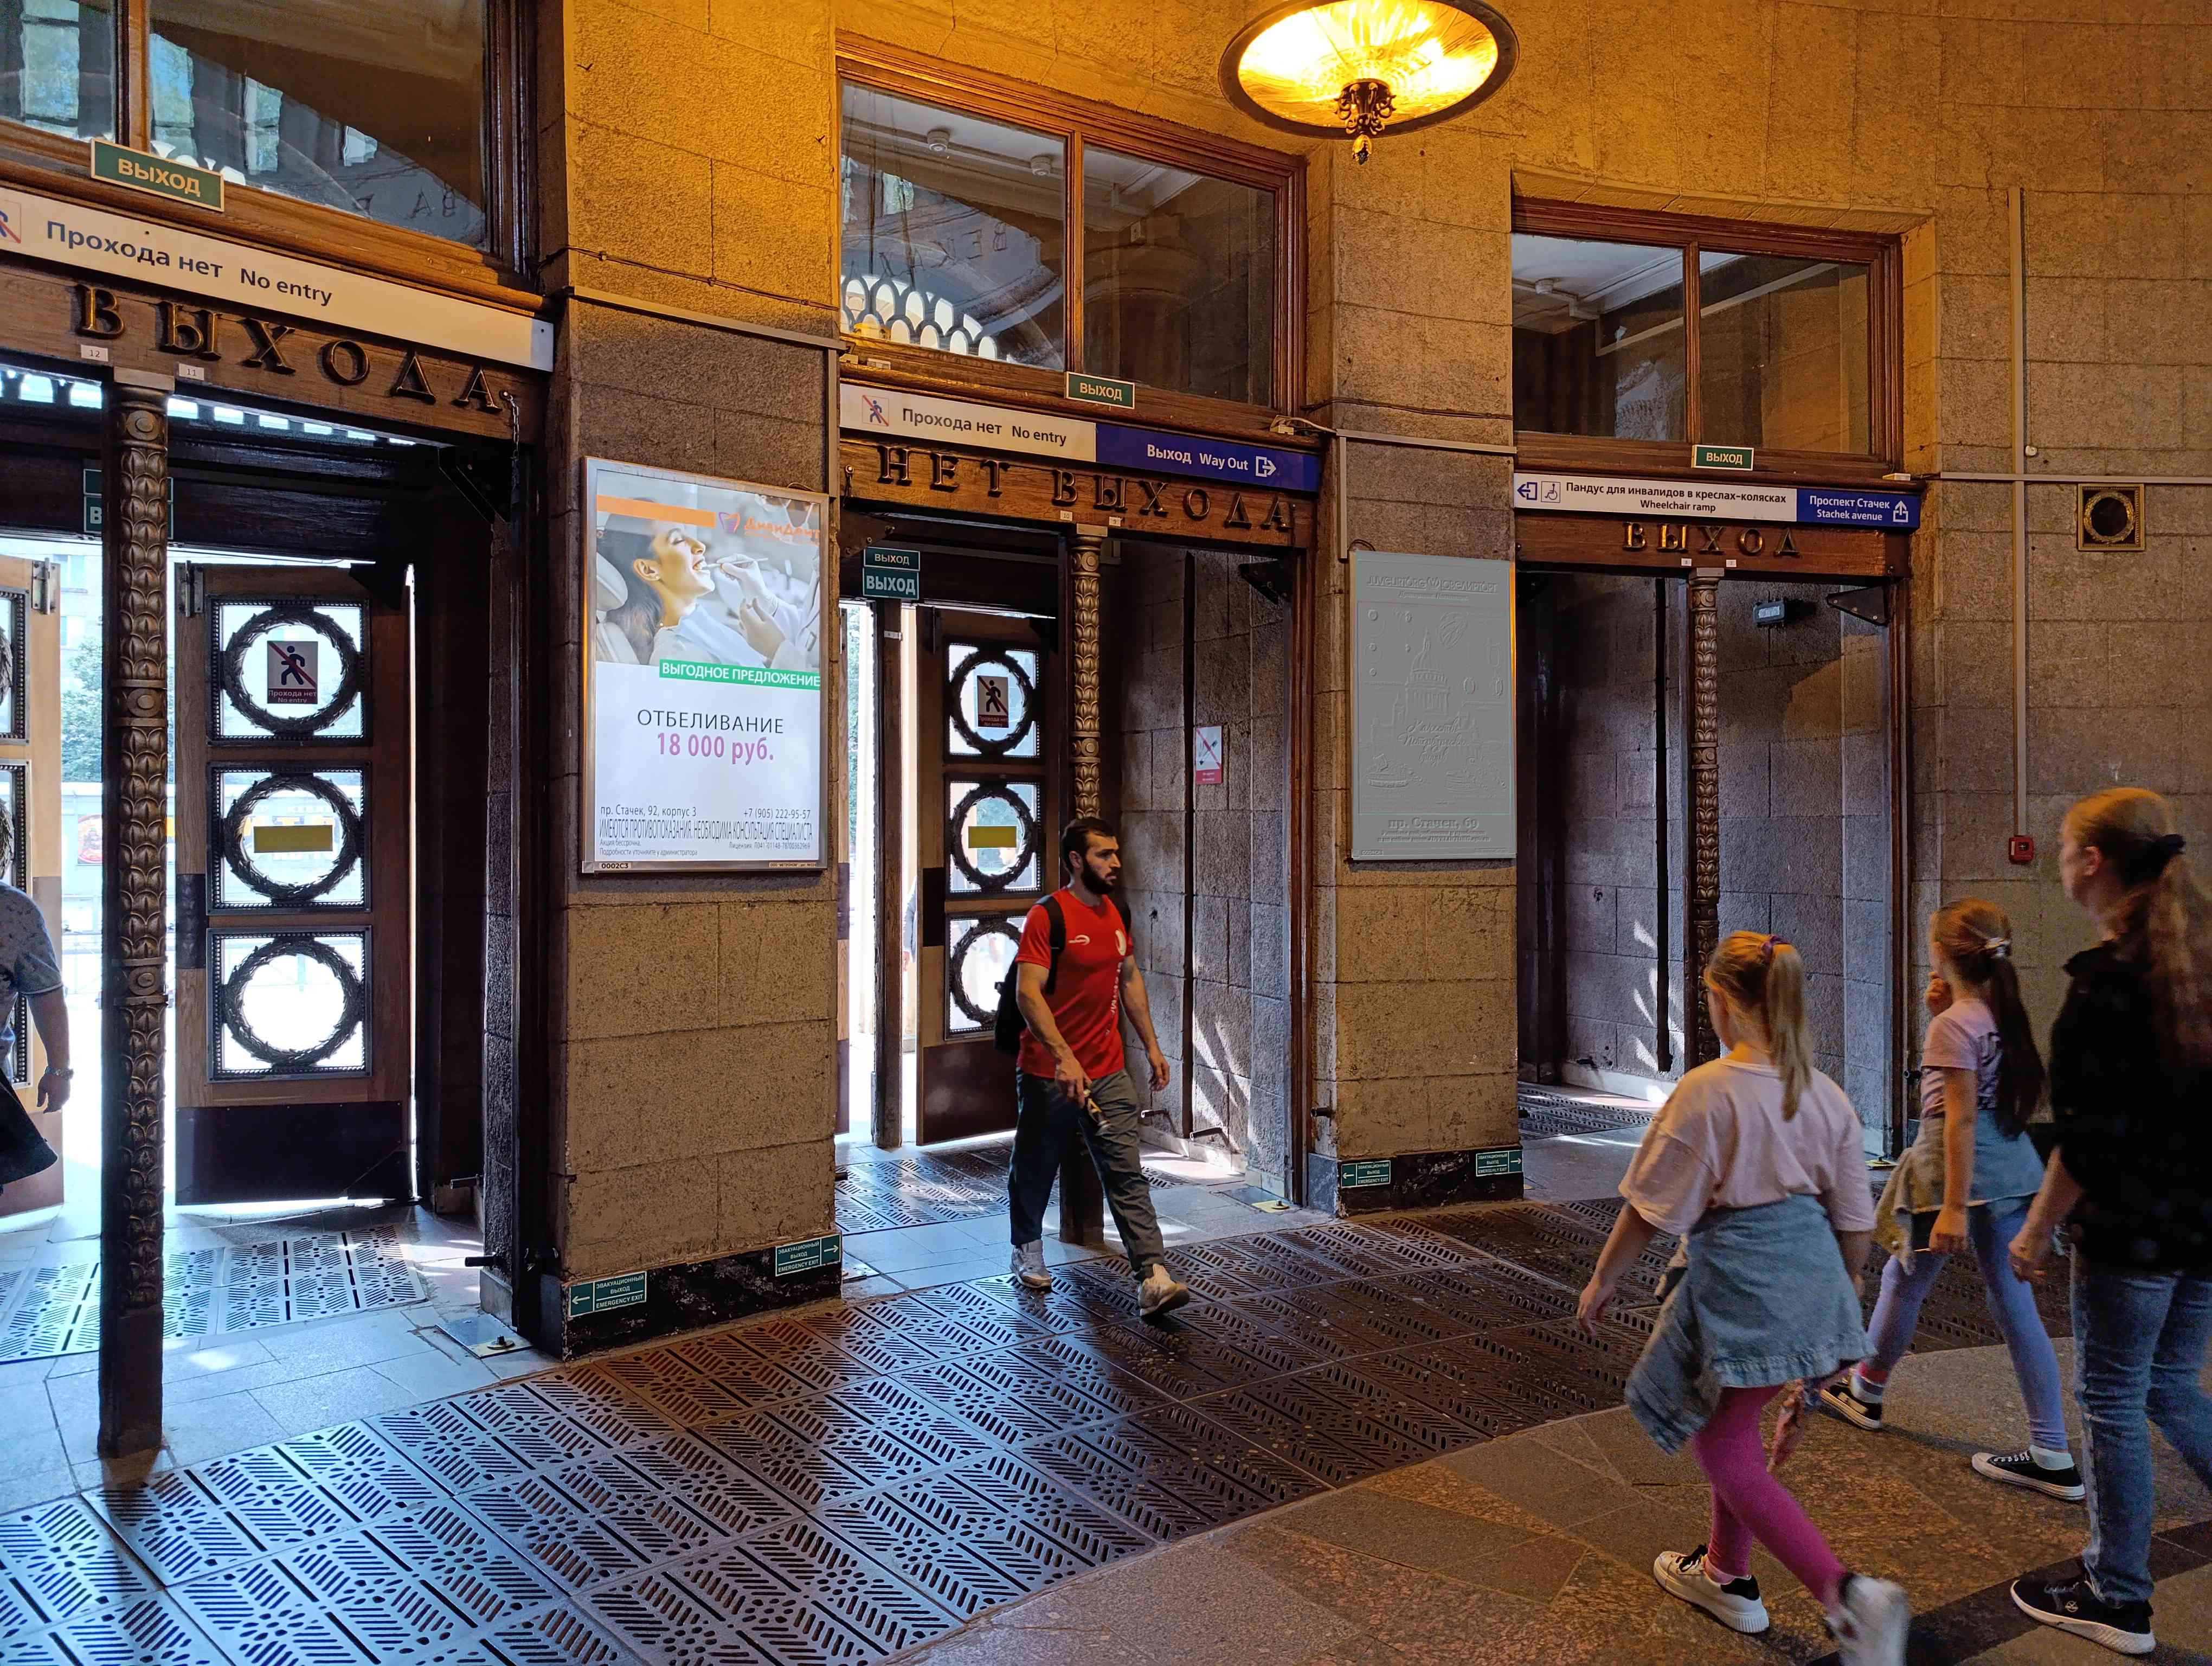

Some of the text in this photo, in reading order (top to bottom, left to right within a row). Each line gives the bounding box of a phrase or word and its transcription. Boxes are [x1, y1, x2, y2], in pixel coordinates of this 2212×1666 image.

[118, 158, 201, 196] ВЫХОД
[47, 221, 222, 278] Прохода нет
[240, 268, 333, 306] No entry
[77, 284, 502, 413] ВЫХОДА
[89, 349, 100, 357] 12
[1080, 382, 1123, 401] ВЫХОД
[903, 408, 1002, 434] Прохода нет
[1012, 426, 1066, 446] No entry
[1147, 444, 1192, 465] Выход
[1199, 452, 1249, 471] Way Out
[1706, 451, 1743, 466] ВЫХОД
[878, 445, 1293, 531] НЕТ ВЫХОДА
[1566, 483, 1604, 495] Пандус
[1606, 487, 1625, 496] для
[1628, 488, 1684, 498] инвалидов
[1696, 492, 1786, 503] креслах-колясках
[1641, 499, 1716, 513] Wheelchair ramp
[1810, 496, 1891, 509] Проспект Стачек
[1817, 509, 1883, 521] Stachek avenue
[1623, 522, 1801, 556] ВЫХОД
[874, 553, 910, 565] ВЫХОД
[866, 575, 916, 596] ВЫХОД
[663, 663, 820, 687] ВЫГОДНОЕ ПРЕДЛОЖЕНИЕ
[638, 709, 783, 734] ОТБЕЛИВАНИЕ
[658, 733, 774, 765] 18 000 руб.
[600, 804, 697, 819] пр. Стачек, 92, корпус 3
[744, 808, 811, 819] +7 (905) 222-95-57
[600, 818, 628, 838] ИМЕЮТСЯ
[694, 820, 732, 841] НЕОБХОДИМА
[734, 821, 774, 841] КОНСУЛЬТАЦИЯ
[775, 822, 812, 841] СПЕЦИАЛИСТА
[600, 848, 632, 856] Подробности
[778, 1241, 819, 1254] ЭВАКУАЦИОННЫЙ
[790, 1251, 807, 1259] ВЫХОД
[778, 1261, 808, 1272] EMERGENCY
[596, 1275, 644, 1289] ЭВАКУАЦИОННЫЙ
[596, 1297, 631, 1308] EMERGENCY
